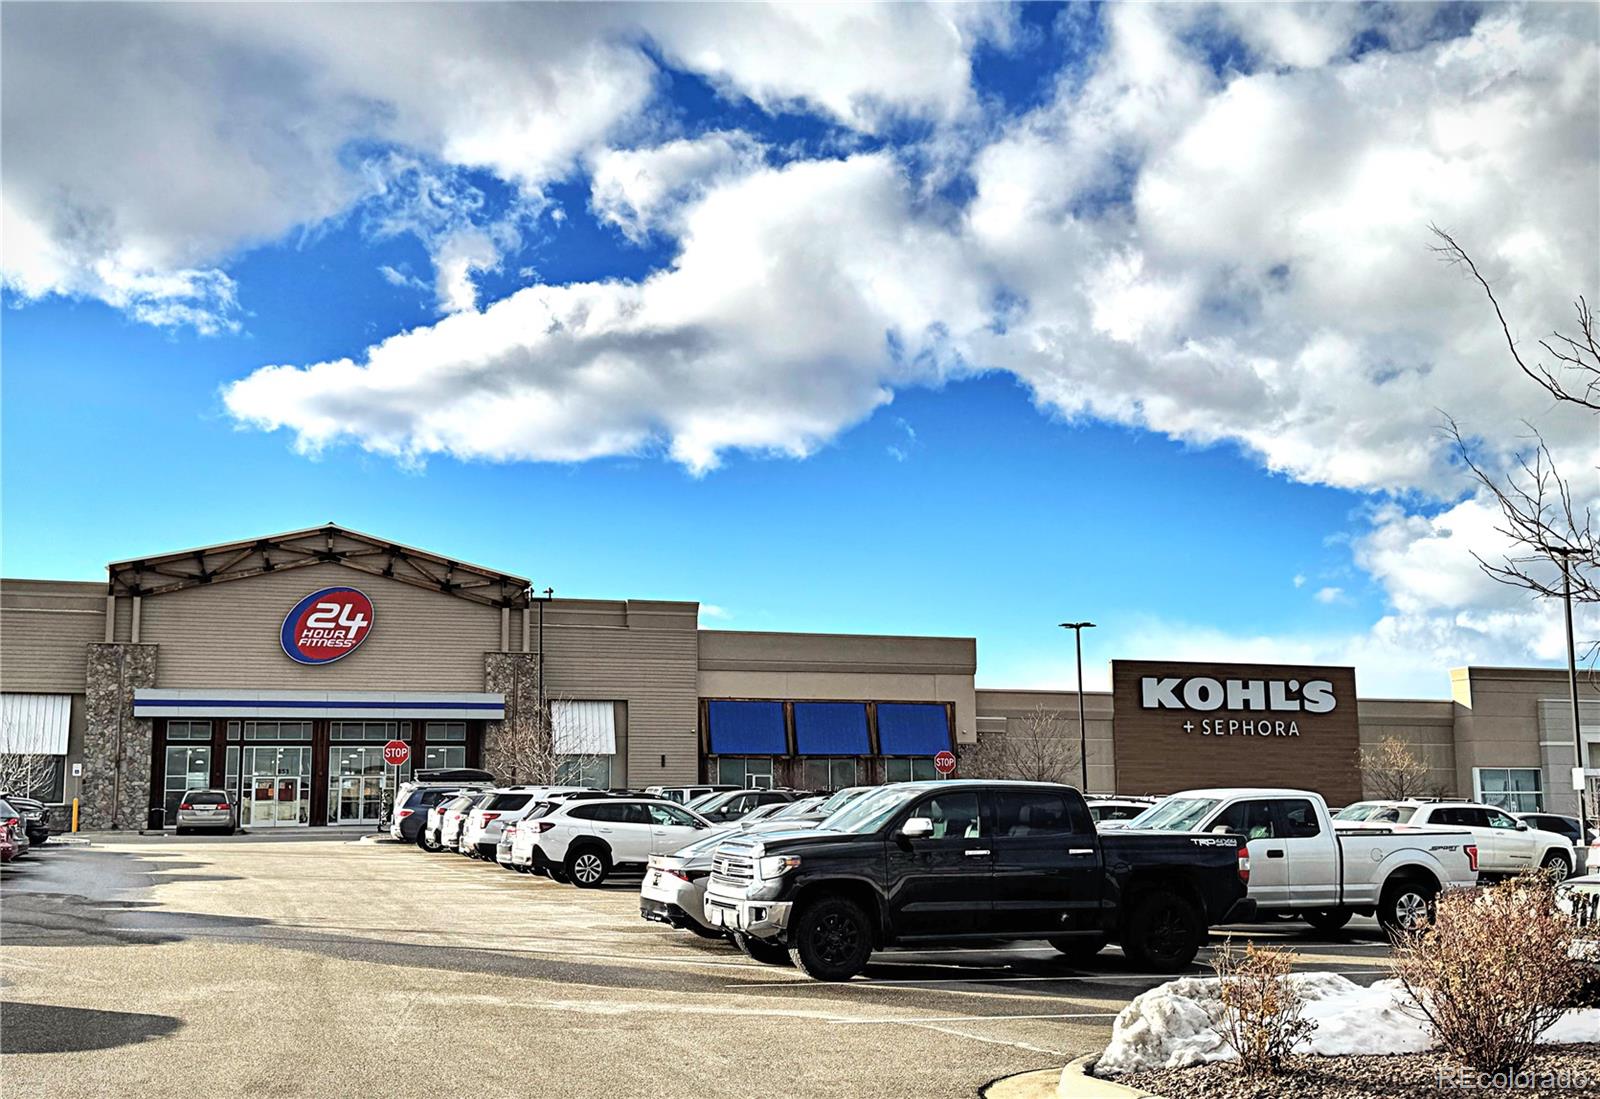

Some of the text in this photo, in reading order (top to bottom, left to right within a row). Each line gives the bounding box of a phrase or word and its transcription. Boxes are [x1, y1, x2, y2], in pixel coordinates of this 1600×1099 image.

[306, 602, 368, 639] 24
[302, 629, 345, 638] HOUR
[298, 638, 352, 648] FITNESS
[1141, 677, 1337, 713] KOHL'S
[1202, 719, 1300, 737] SEPHORA
[385, 747, 408, 758] STOP
[936, 757, 954, 767] STOP
